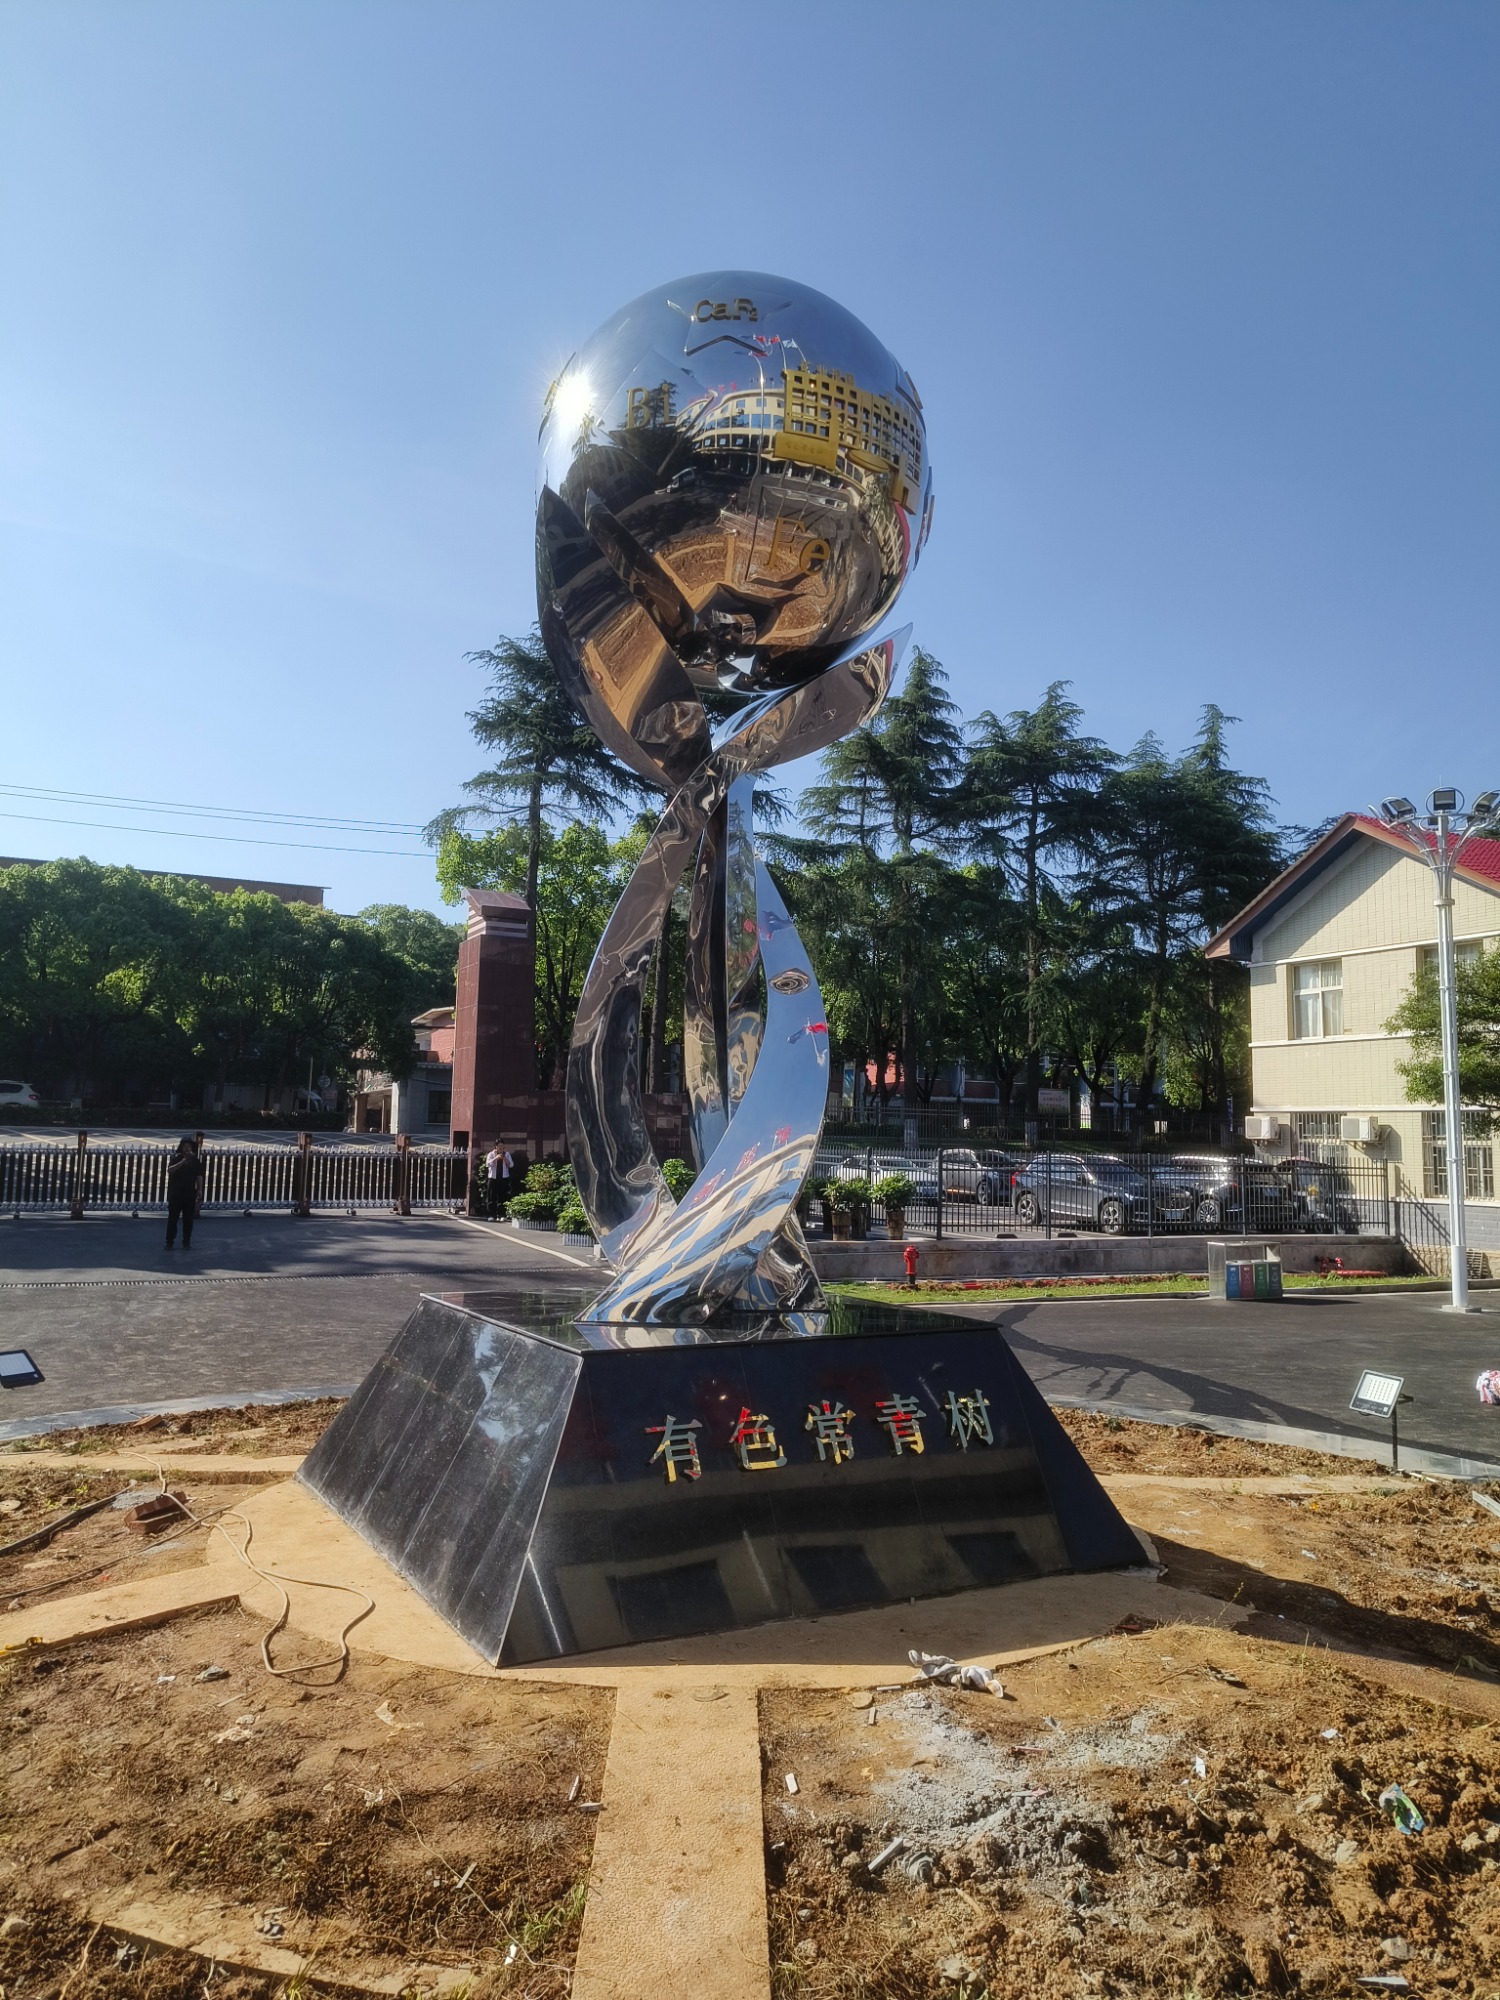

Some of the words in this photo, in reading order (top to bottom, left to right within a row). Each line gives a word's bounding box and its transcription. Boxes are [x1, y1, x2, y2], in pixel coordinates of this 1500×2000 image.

[627, 383, 677, 430] Bi
[764, 516, 830, 576] Fe
[644, 1389, 994, 1482] 有色常青树
